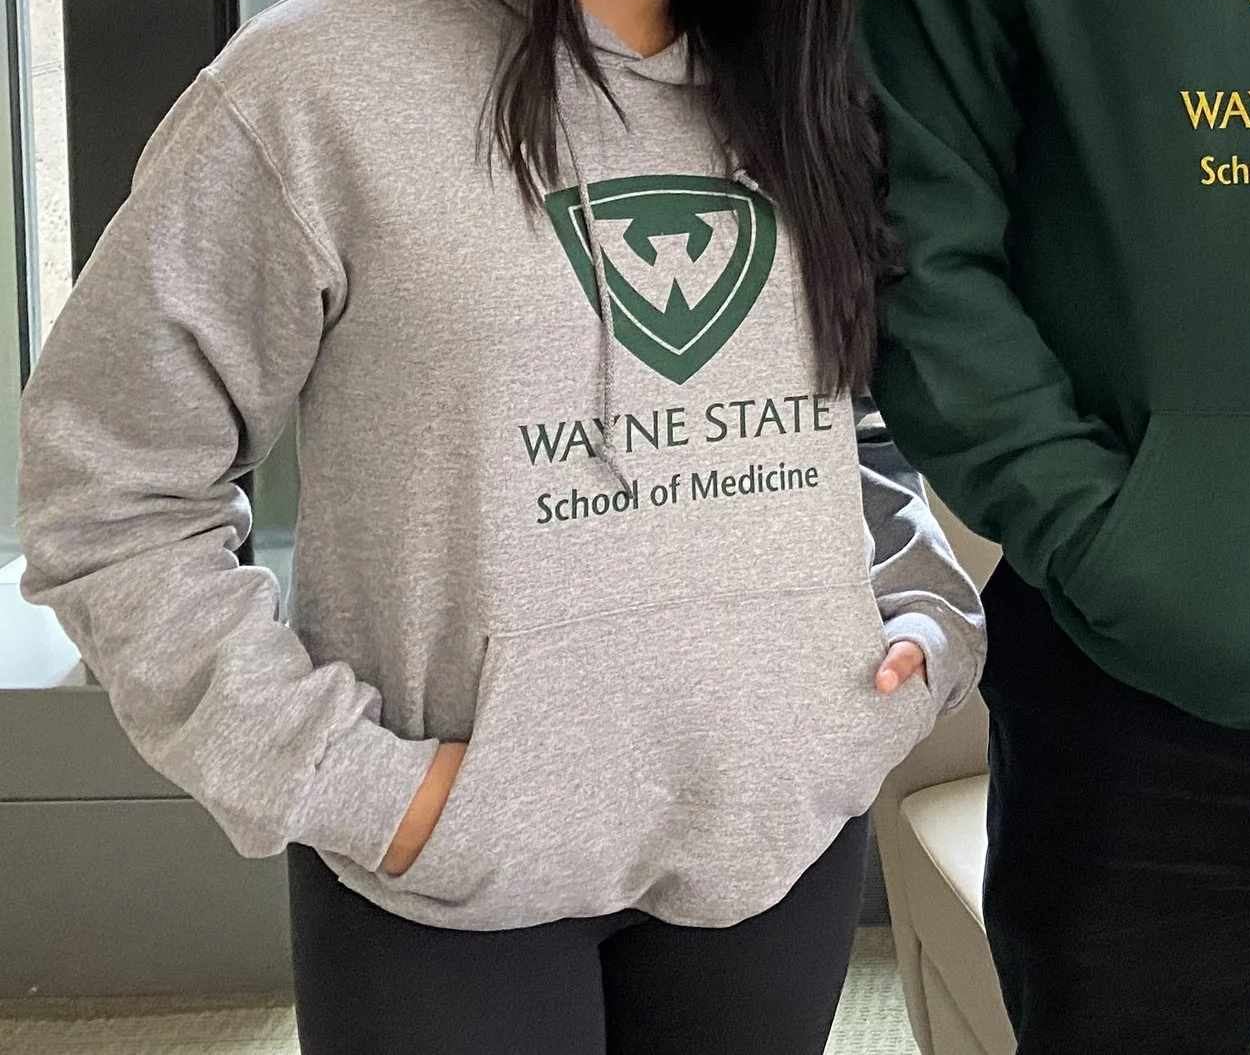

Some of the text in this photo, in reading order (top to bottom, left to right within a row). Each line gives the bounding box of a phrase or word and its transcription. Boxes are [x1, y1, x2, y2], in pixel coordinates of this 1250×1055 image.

[705, 393, 833, 443] STATE
[536, 461, 819, 525] School of Medicine
